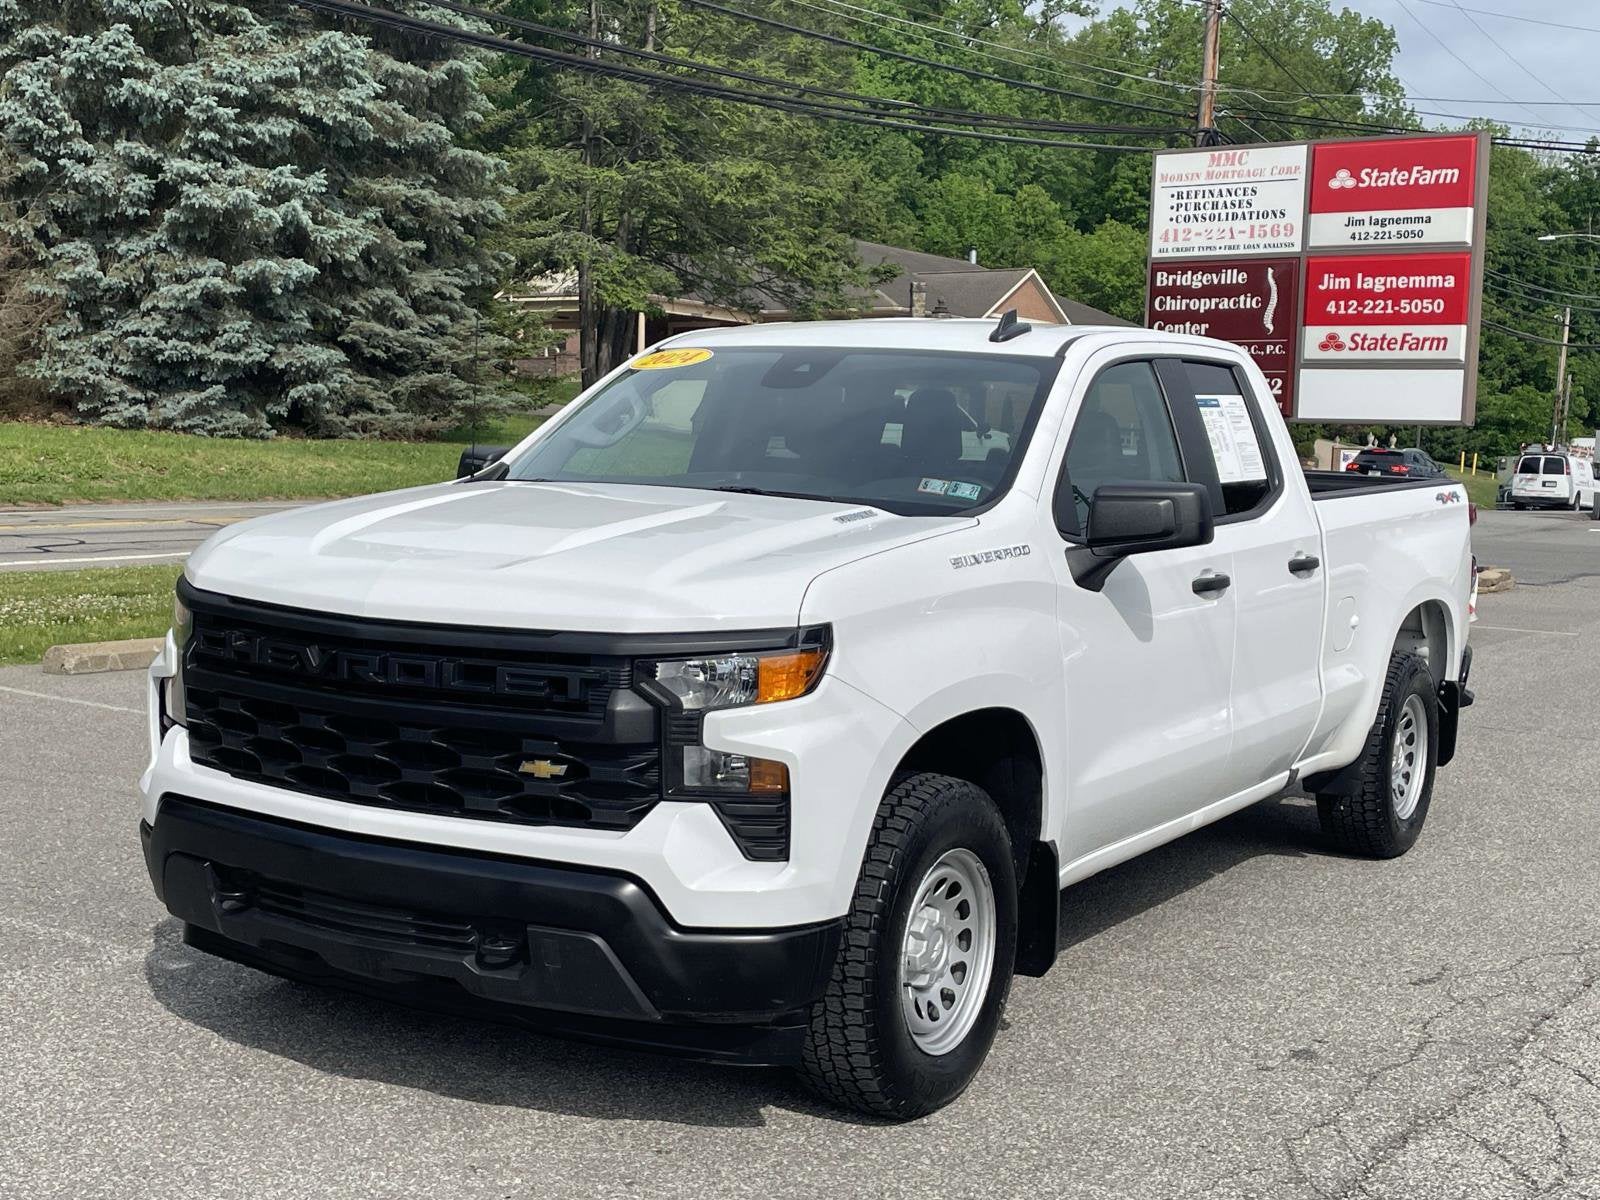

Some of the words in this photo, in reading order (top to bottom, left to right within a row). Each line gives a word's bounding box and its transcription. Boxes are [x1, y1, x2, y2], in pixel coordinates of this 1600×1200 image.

[1208, 151, 1249, 167] MMC
[1176, 186, 1258, 200] REFINANCES
[1175, 199, 1253, 212] PURCHASES
[1175, 209, 1286, 224] CONSOLIDATIONS
[1344, 216, 1365, 227] Jim
[1369, 215, 1432, 228] Iagnemma
[1159, 222, 1294, 243] 412-221-1569
[1350, 229, 1424, 241] 412-221-5050
[1262, 241, 1295, 249] ANALYSIS
[1156, 268, 1248, 289] Bridgeville
[1318, 273, 1350, 290] Jim
[1356, 272, 1456, 293] Iagnemma
[1154, 293, 1262, 313] Chiropractic
[1326, 299, 1445, 314] 412-221-5050
[1153, 320, 1209, 336] Center
[1266, 344, 1286, 355] P.C.
[949, 544, 1031, 569] SILVERADO
[199, 627, 608, 701] CHEVROLET
